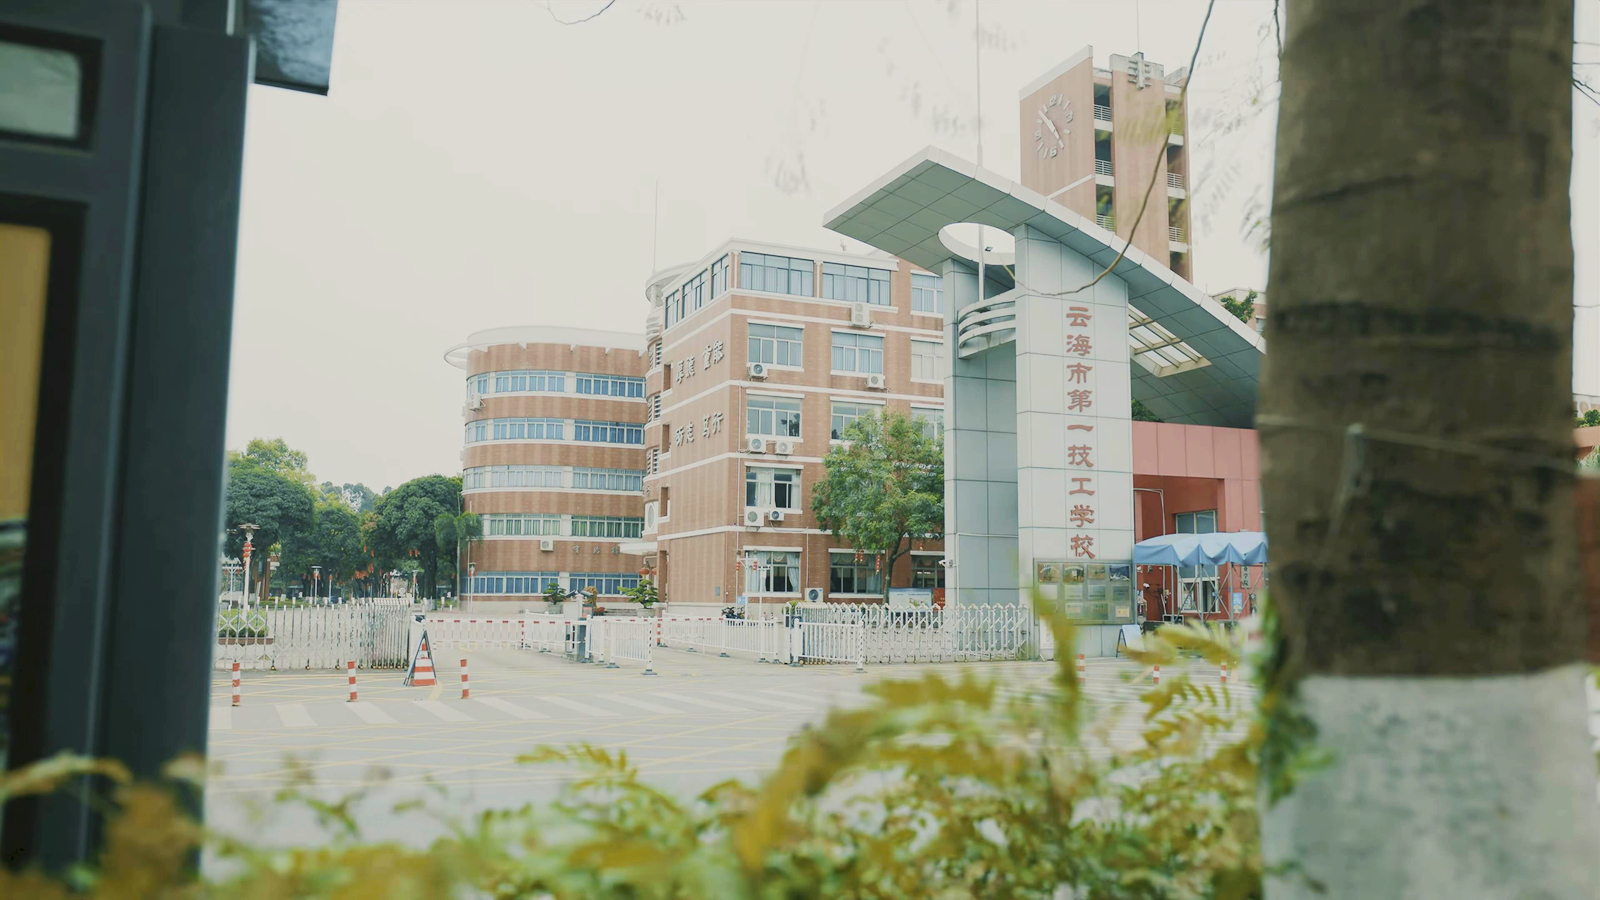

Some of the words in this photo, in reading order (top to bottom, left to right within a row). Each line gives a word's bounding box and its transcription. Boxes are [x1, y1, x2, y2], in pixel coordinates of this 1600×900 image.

[1066, 306, 1096, 560] 云海市第一技工学校
